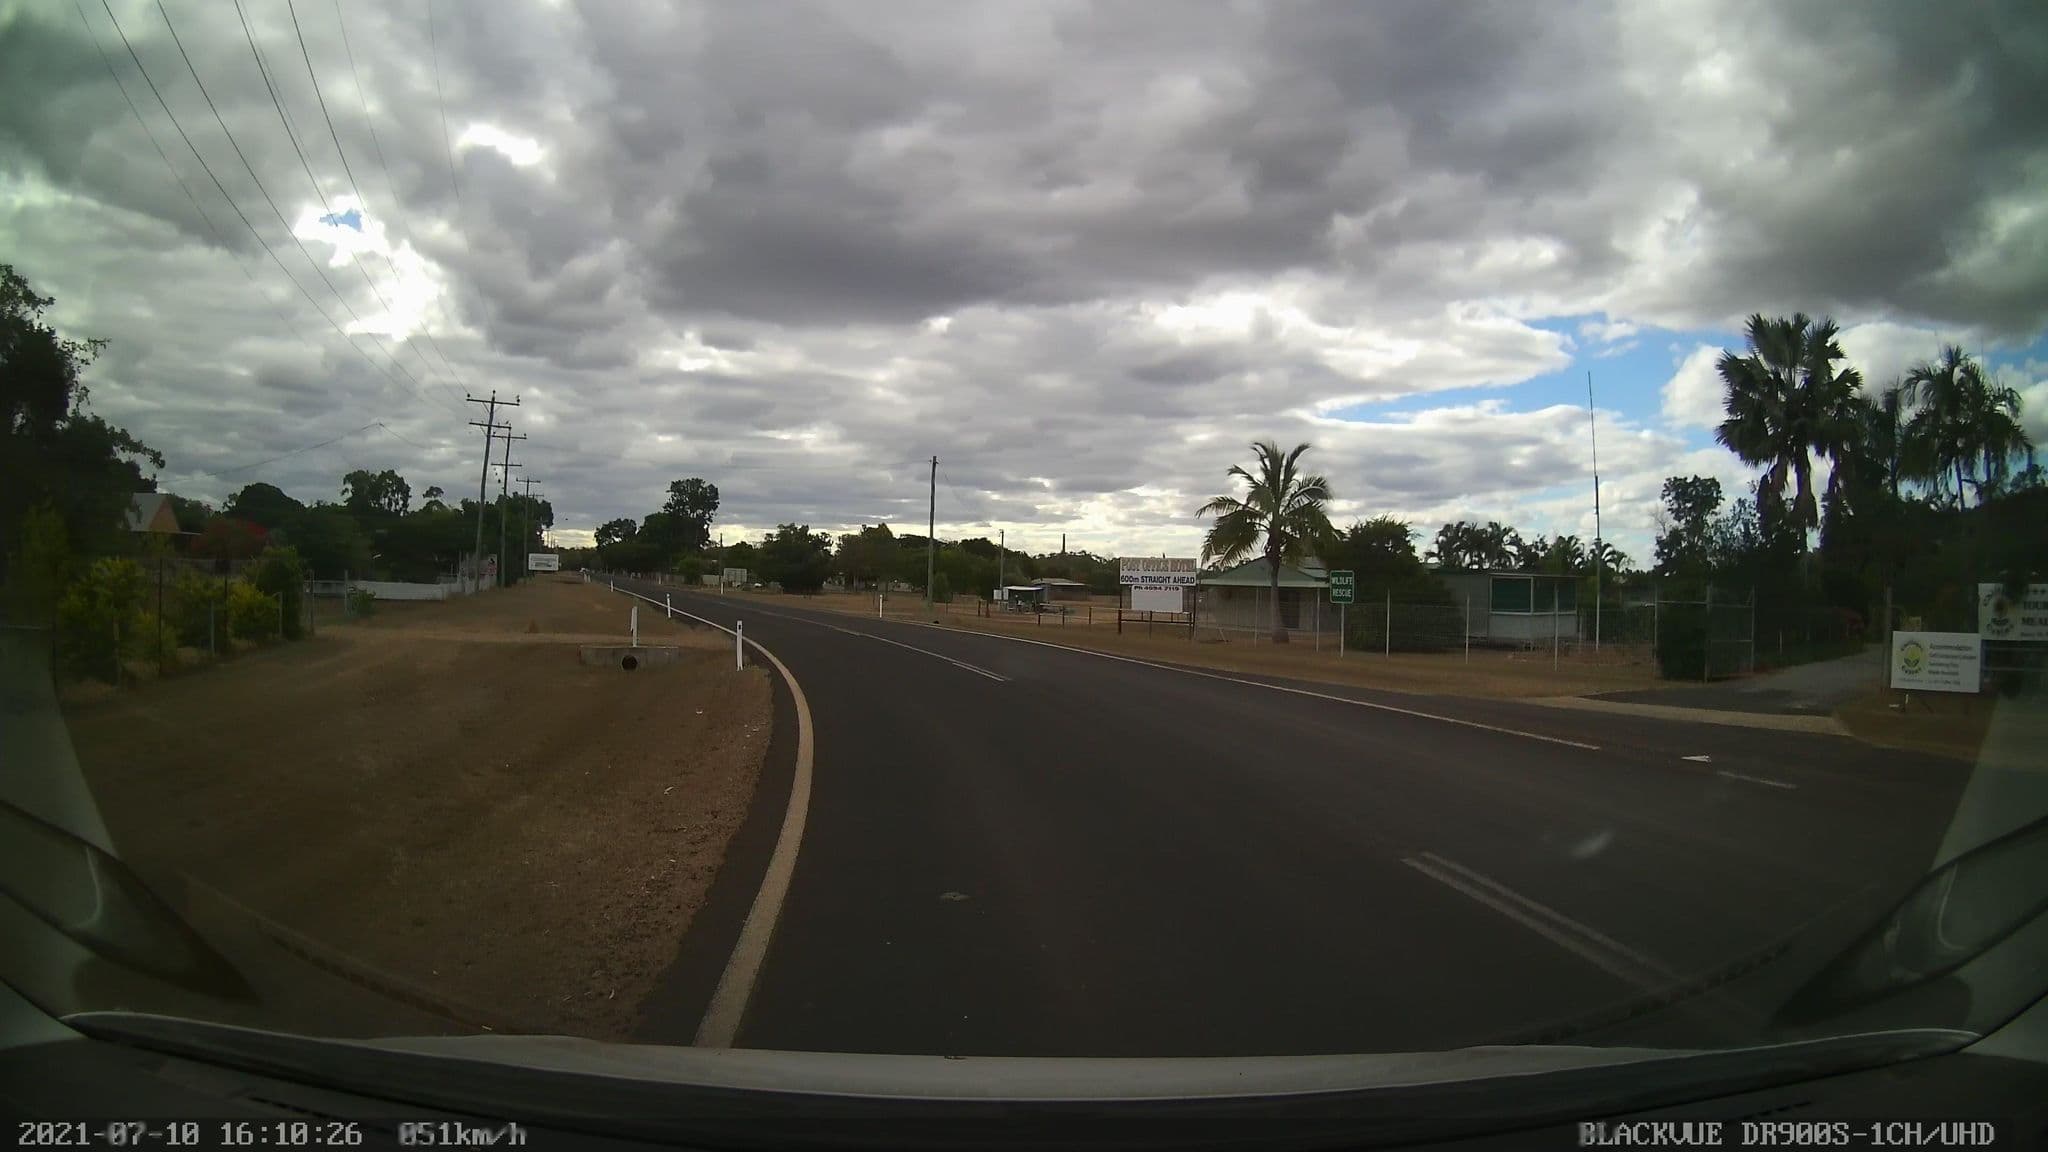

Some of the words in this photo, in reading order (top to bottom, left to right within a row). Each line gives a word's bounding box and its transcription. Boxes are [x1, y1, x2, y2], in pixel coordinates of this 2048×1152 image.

[1121, 575, 1140, 583] 600m
[1140, 575, 1170, 584] STRAIGHT
[1172, 576, 1195, 584] AHEAD
[1331, 577, 1353, 585] WILDLIFE
[1332, 588, 1352, 598] RESCUE
